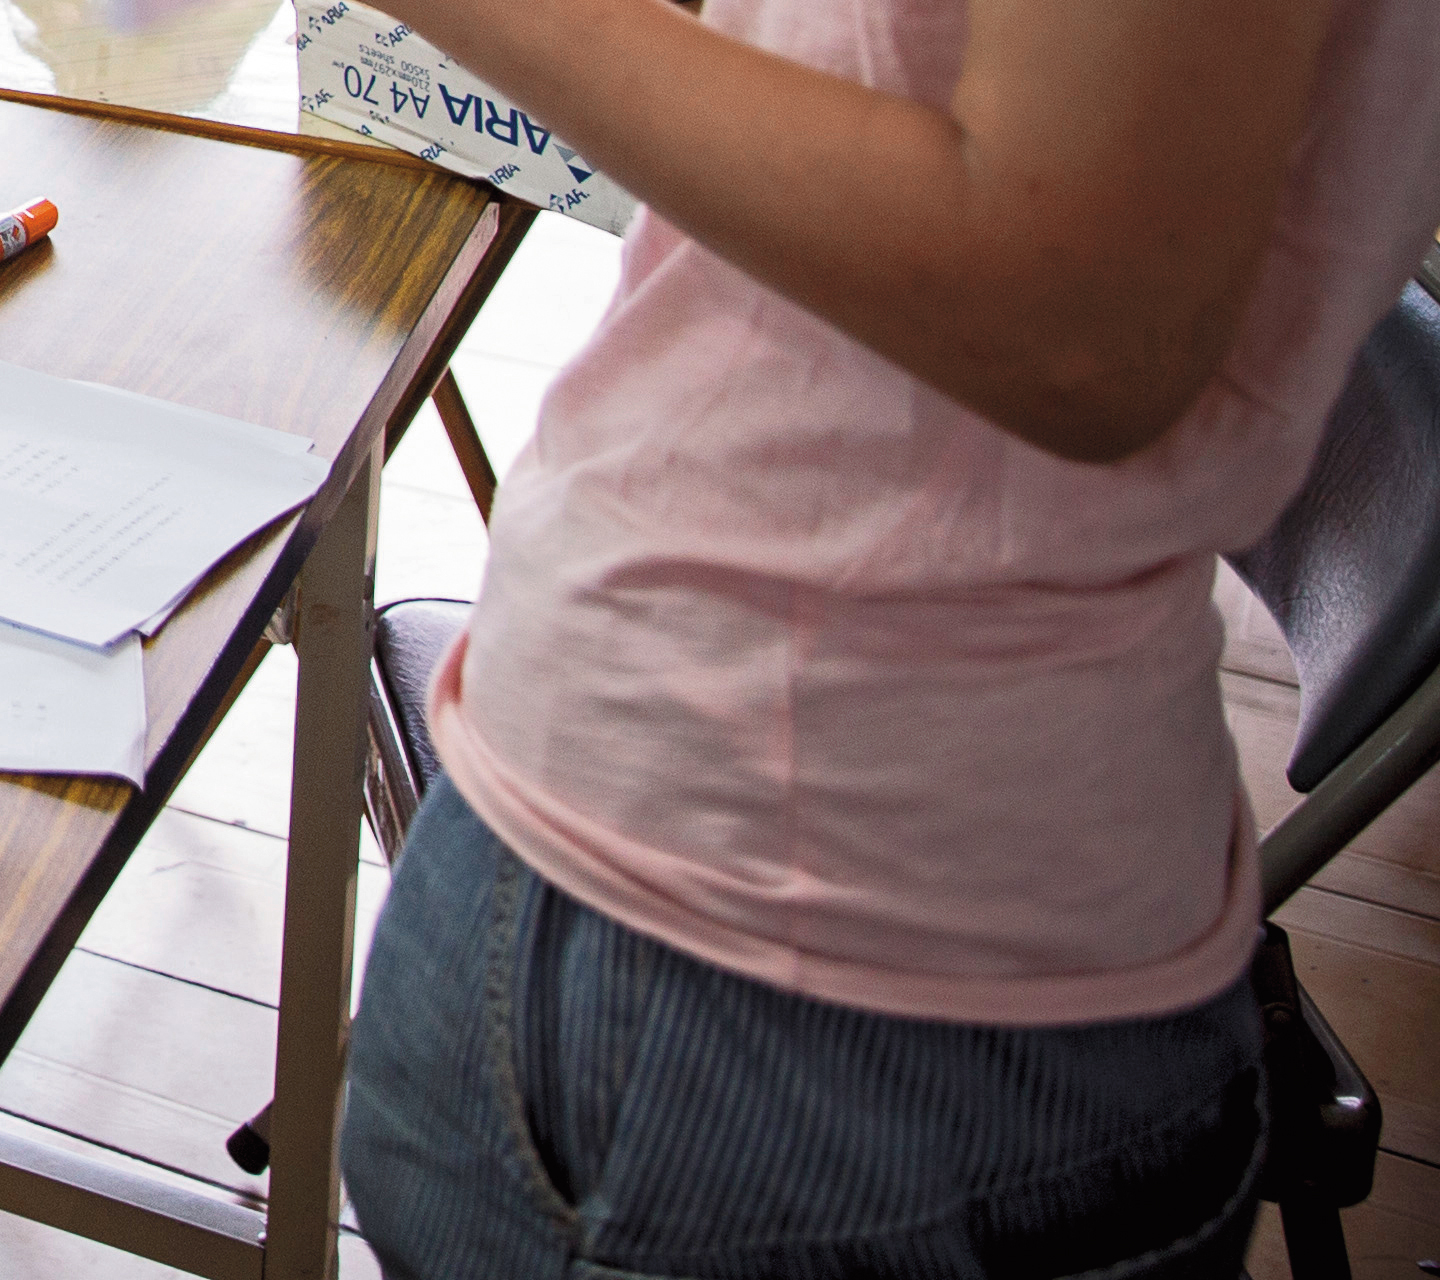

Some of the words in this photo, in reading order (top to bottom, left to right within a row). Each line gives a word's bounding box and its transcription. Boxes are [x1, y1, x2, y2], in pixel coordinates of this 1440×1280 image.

[344, 65, 379, 106] 70
[389, 81, 430, 119] A4
[437, 83, 552, 155] ARIA
